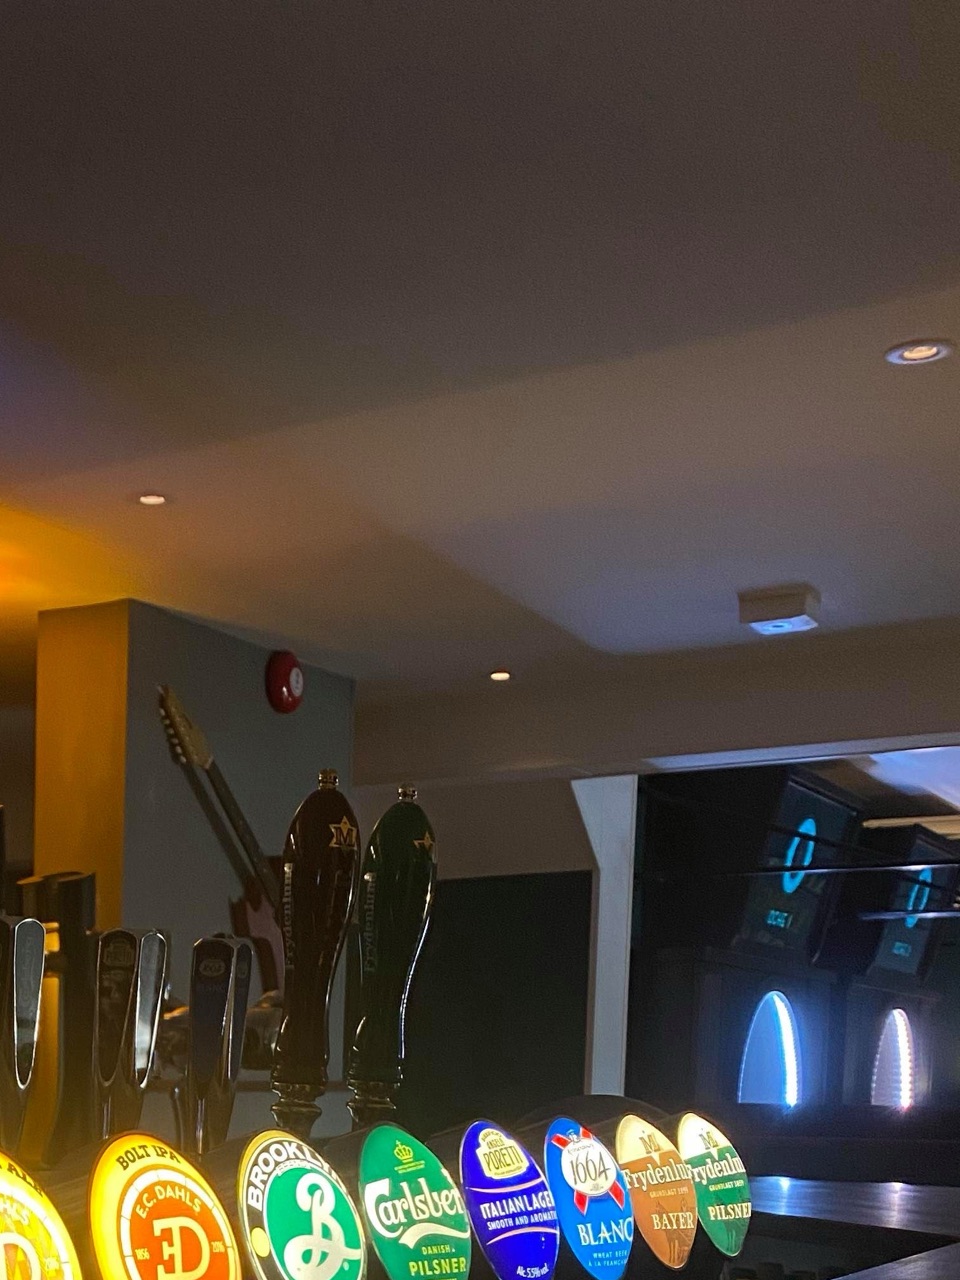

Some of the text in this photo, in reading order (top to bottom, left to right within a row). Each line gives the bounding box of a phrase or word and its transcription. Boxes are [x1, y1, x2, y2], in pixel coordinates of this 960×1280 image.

[116, 1144, 181, 1171] BOLT IPA
[483, 1146, 523, 1171] PORETTI
[570, 1152, 611, 1185] 1664
[135, 1185, 202, 1220] E.C. DAHLS
[364, 1177, 464, 1238] Carlsber
[480, 1190, 555, 1220] ITALIAN LAGE
[487, 1211, 557, 1231] SMOOTH AND AROMATI
[652, 1212, 695, 1230] BAYER
[422, 1245, 451, 1255] DANISH
[409, 1256, 467, 1277] PILSNER
